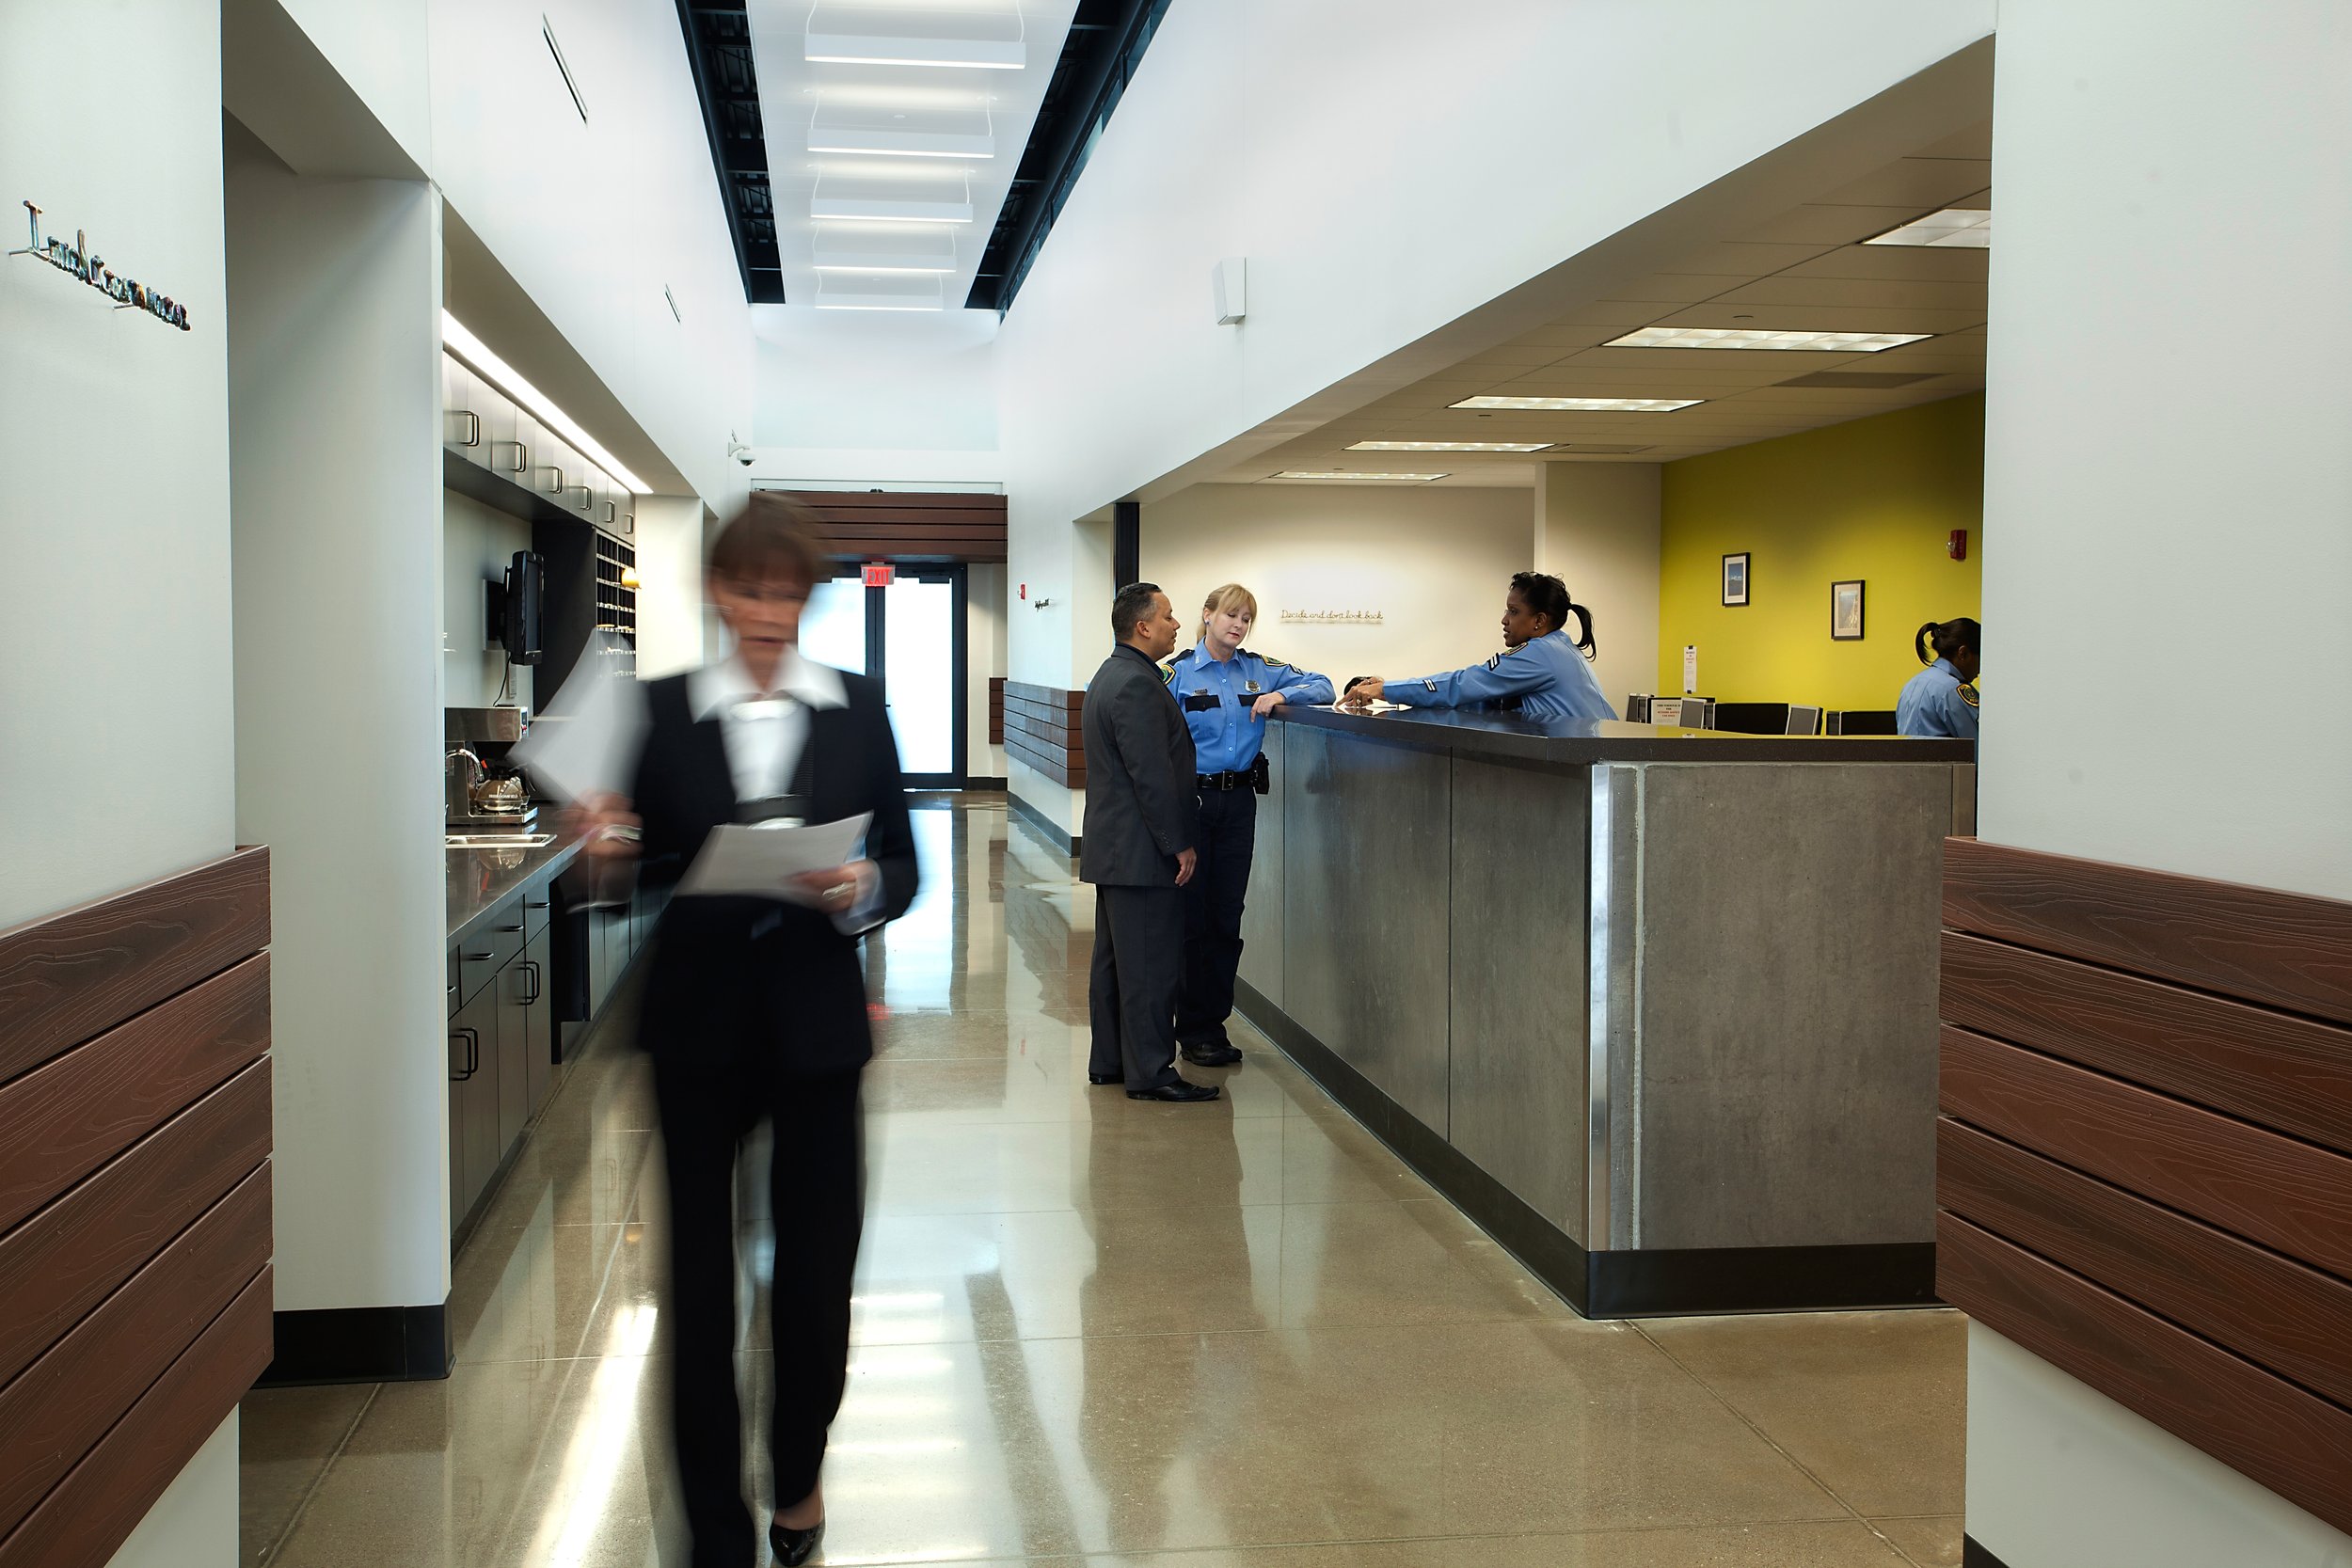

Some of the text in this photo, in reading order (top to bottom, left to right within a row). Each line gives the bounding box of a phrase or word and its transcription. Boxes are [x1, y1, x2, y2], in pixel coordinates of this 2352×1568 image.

[867, 568, 890, 584] EXIT
[1280, 610, 1308, 619] Decide
[1309, 610, 1326, 619] and
[1345, 610, 1362, 619] look
